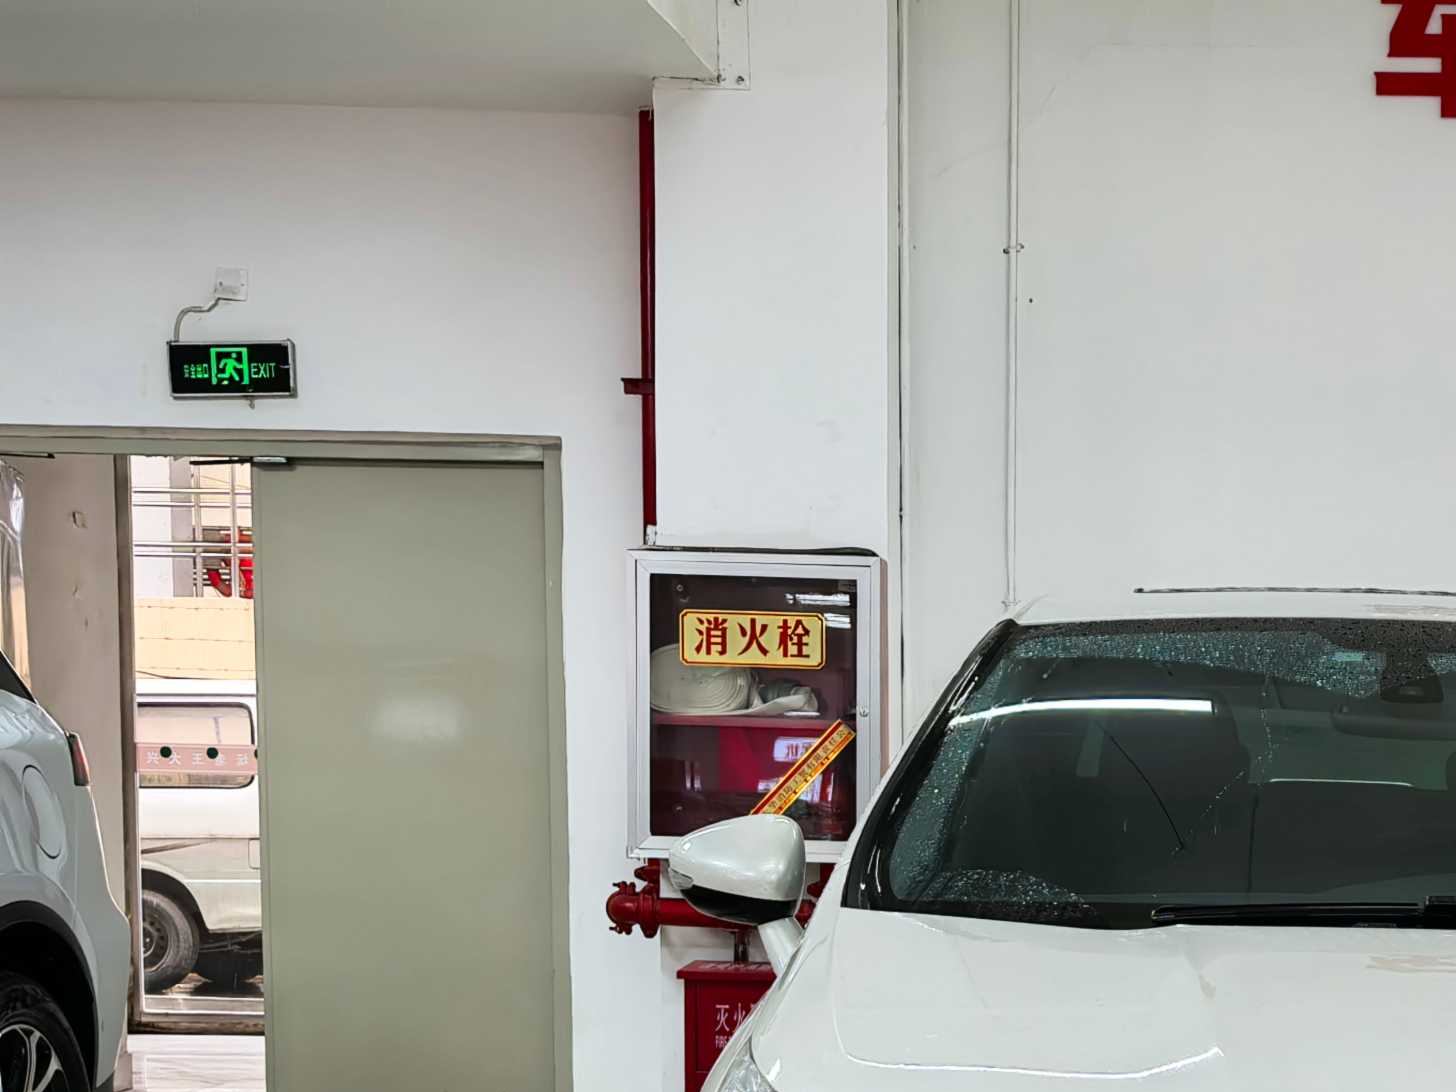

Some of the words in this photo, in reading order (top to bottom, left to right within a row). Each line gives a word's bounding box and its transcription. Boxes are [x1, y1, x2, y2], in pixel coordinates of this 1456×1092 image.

[251, 362, 276, 378] EXIT
[694, 617, 811, 659] 消火栓
[715, 1002, 755, 1033] 灭火
